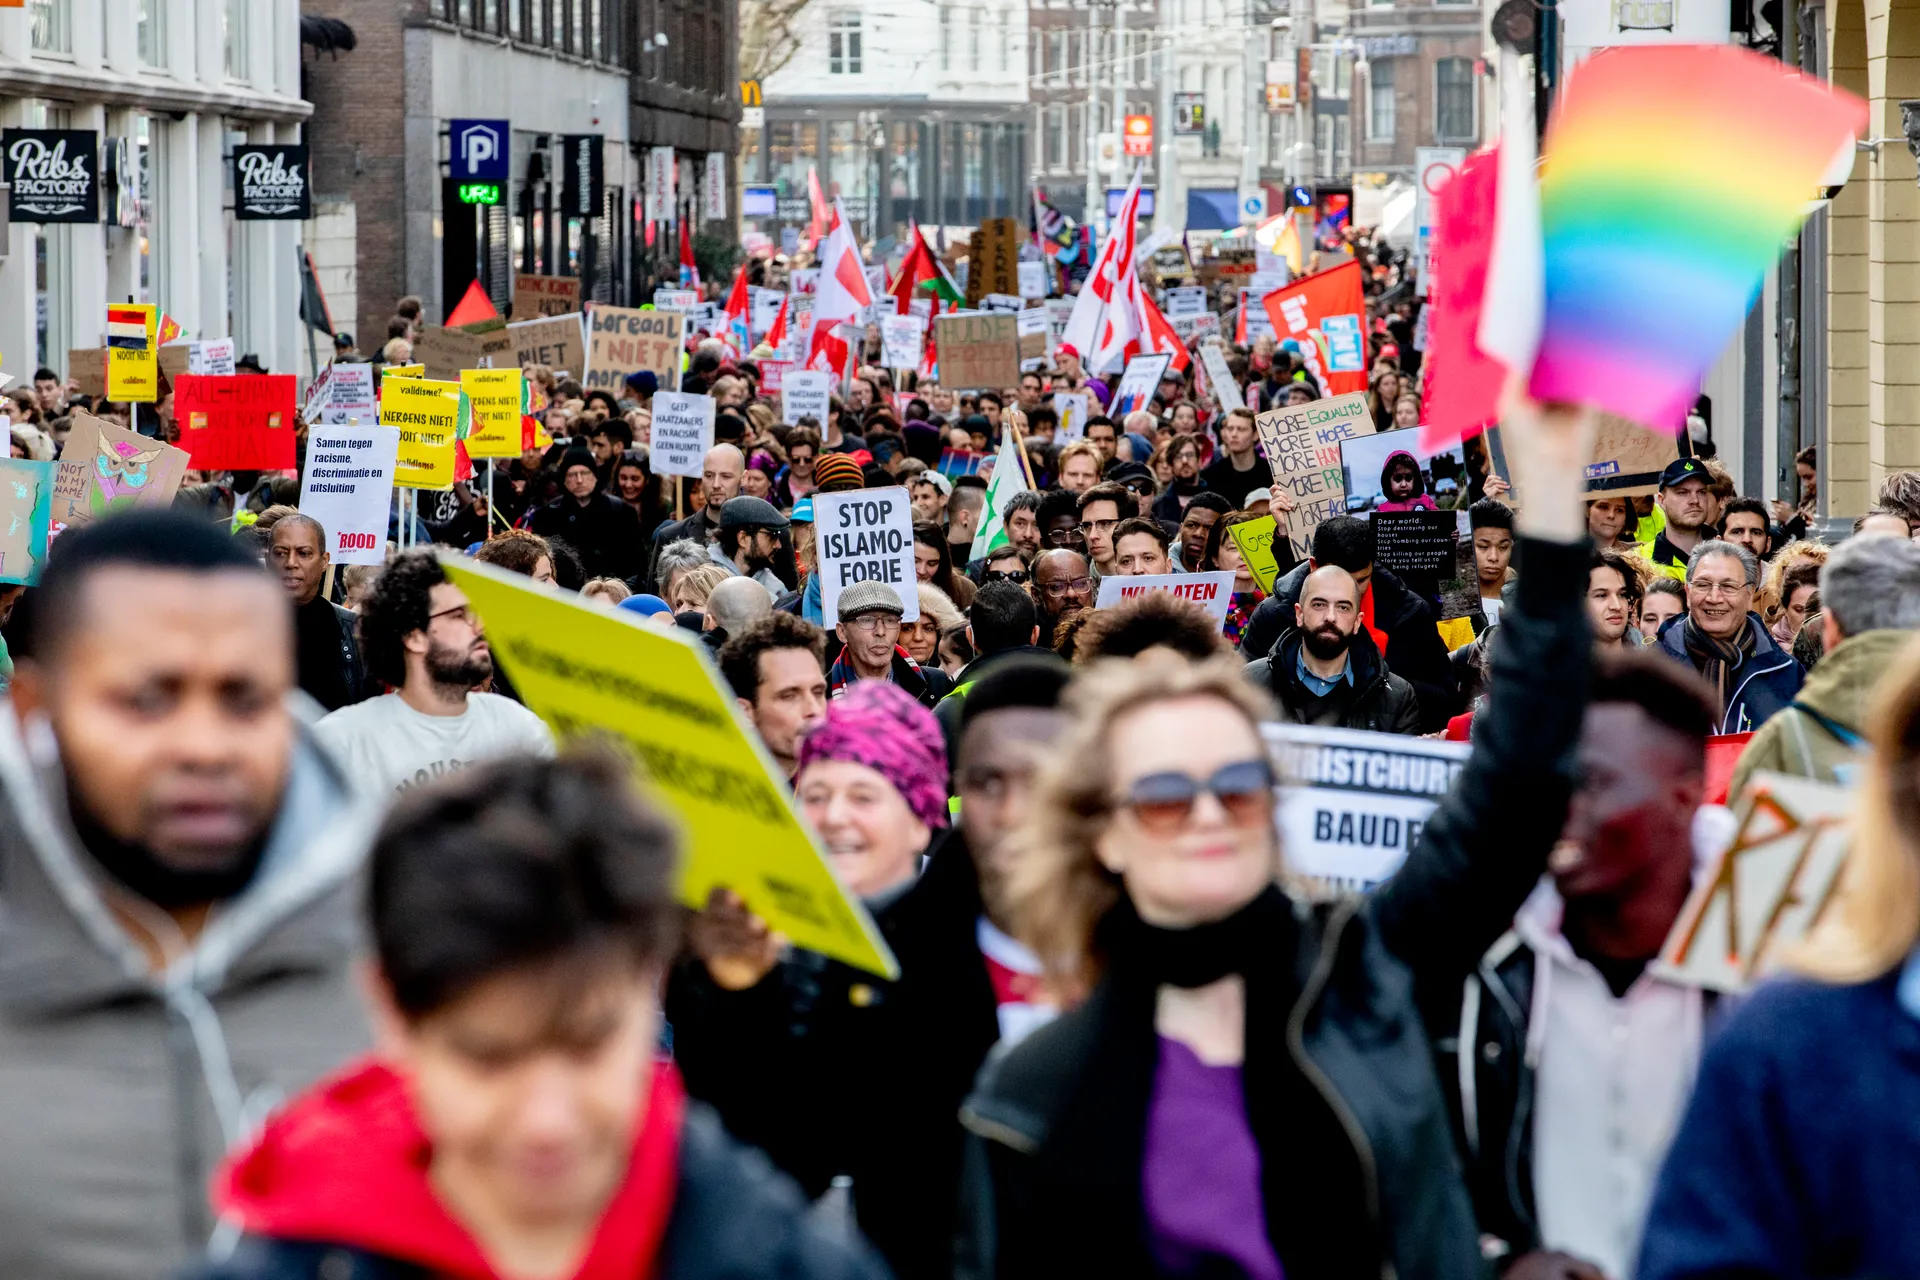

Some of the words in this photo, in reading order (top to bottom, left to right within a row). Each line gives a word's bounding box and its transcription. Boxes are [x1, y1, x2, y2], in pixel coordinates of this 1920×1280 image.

[9, 138, 90, 180] Ribs
[468, 135, 493, 174] P
[238, 152, 304, 185] Ribs
[14, 180, 90, 195] FACTORY
[243, 185, 304, 198] FACTORY
[517, 343, 567, 368] NIET
[608, 339, 669, 368] NIET
[400, 386, 442, 397] validisme?
[384, 410, 427, 425] NERGENS
[429, 415, 453, 427] NIET!
[1257, 413, 1309, 438] MORE
[1307, 402, 1363, 426] EQUALITY
[421, 432, 444, 445] NIET!
[658, 428, 668, 437] EN
[669, 429, 699, 439] RACISME
[1264, 432, 1313, 456] MORE
[1316, 423, 1356, 445] HOPE
[316, 438, 347, 448] Samen
[348, 439, 373, 450] tegen
[656, 441, 674, 450] GEEN
[675, 442, 702, 453] RUIMTE
[314, 453, 352, 464] racisme,
[669, 455, 688, 465] MEER
[1268, 450, 1317, 477] MORE
[60, 462, 86, 476] NOT
[312, 467, 370, 478] discriminatie
[371, 469, 382, 478] en
[56, 474, 67, 483] IN
[70, 477, 87, 488] MY
[310, 483, 355, 494] uitsluiting
[1277, 472, 1323, 498] MORE
[55, 485, 83, 499] NAME
[838, 500, 892, 528] STOP
[339, 533, 376, 549] ROOD
[823, 529, 912, 559] ISLAMO-
[840, 559, 902, 587] FOBIE
